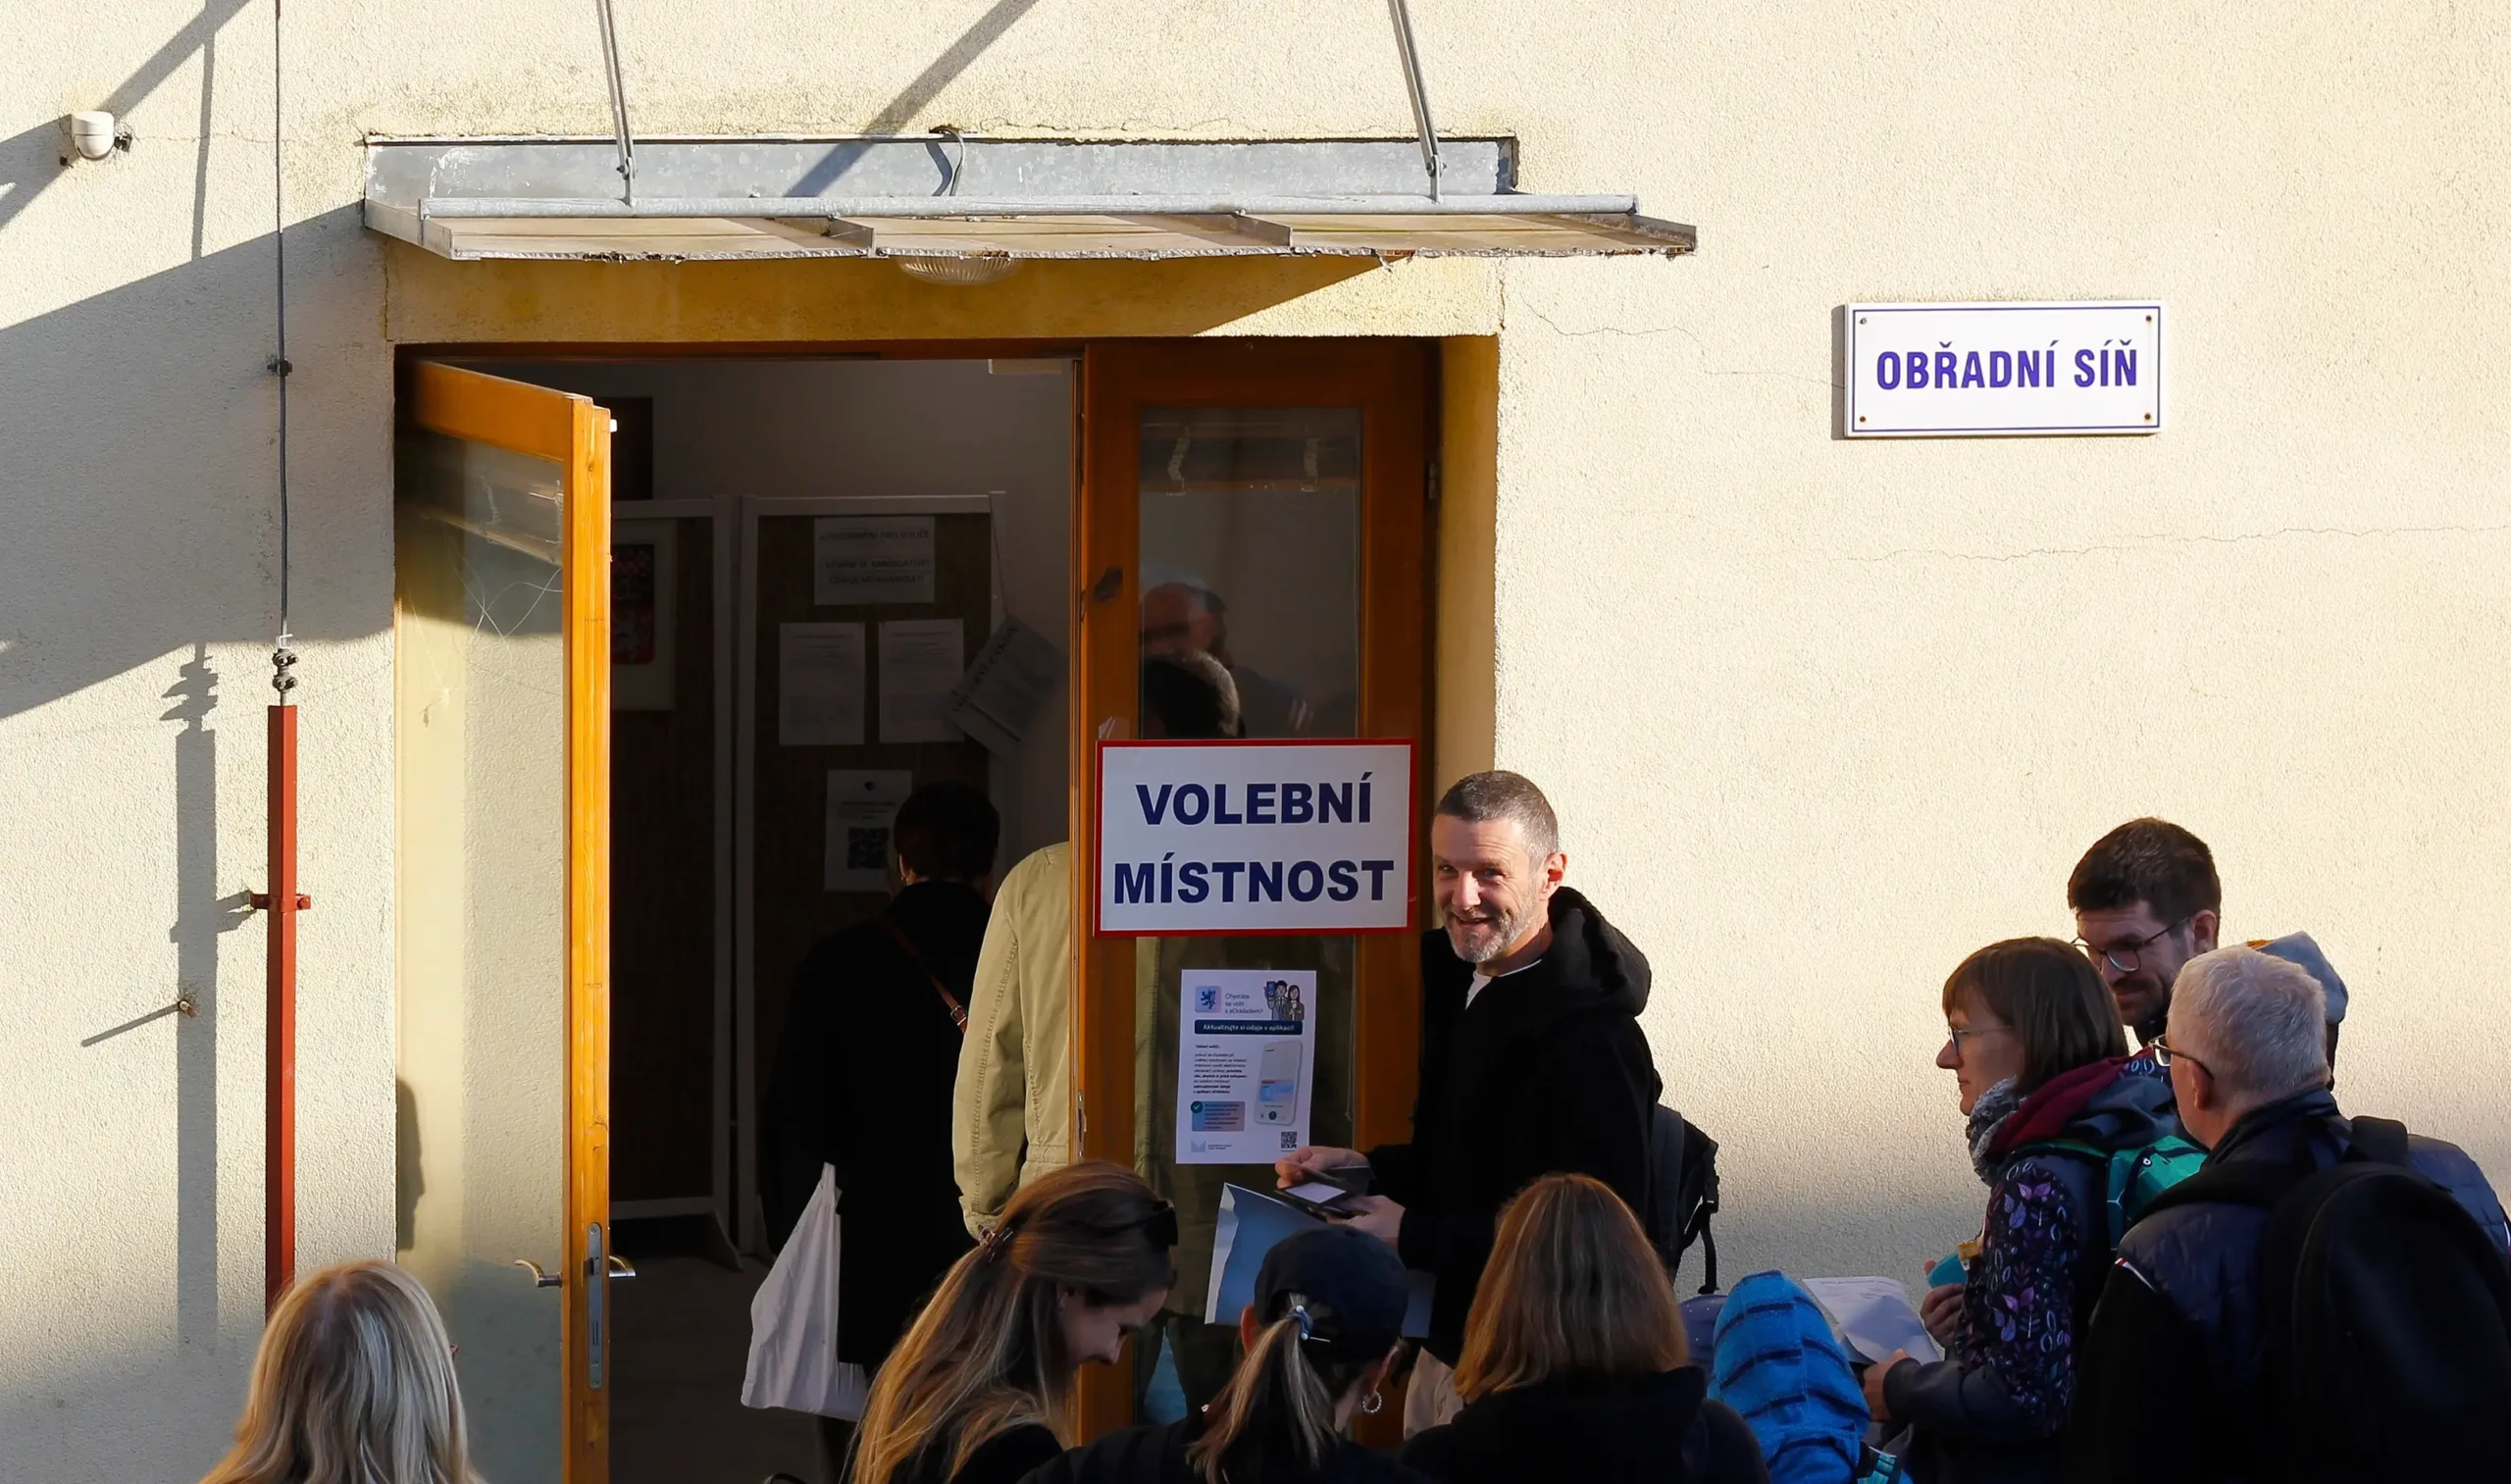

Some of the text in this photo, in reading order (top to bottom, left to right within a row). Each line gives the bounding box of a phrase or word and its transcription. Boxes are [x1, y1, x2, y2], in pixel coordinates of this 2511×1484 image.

[1876, 338, 2137, 390] OBŘADNÍ SÍŇ
[1135, 771, 1373, 825] VOLEBNÍ
[1113, 851, 1395, 904] MÍSTNOST
